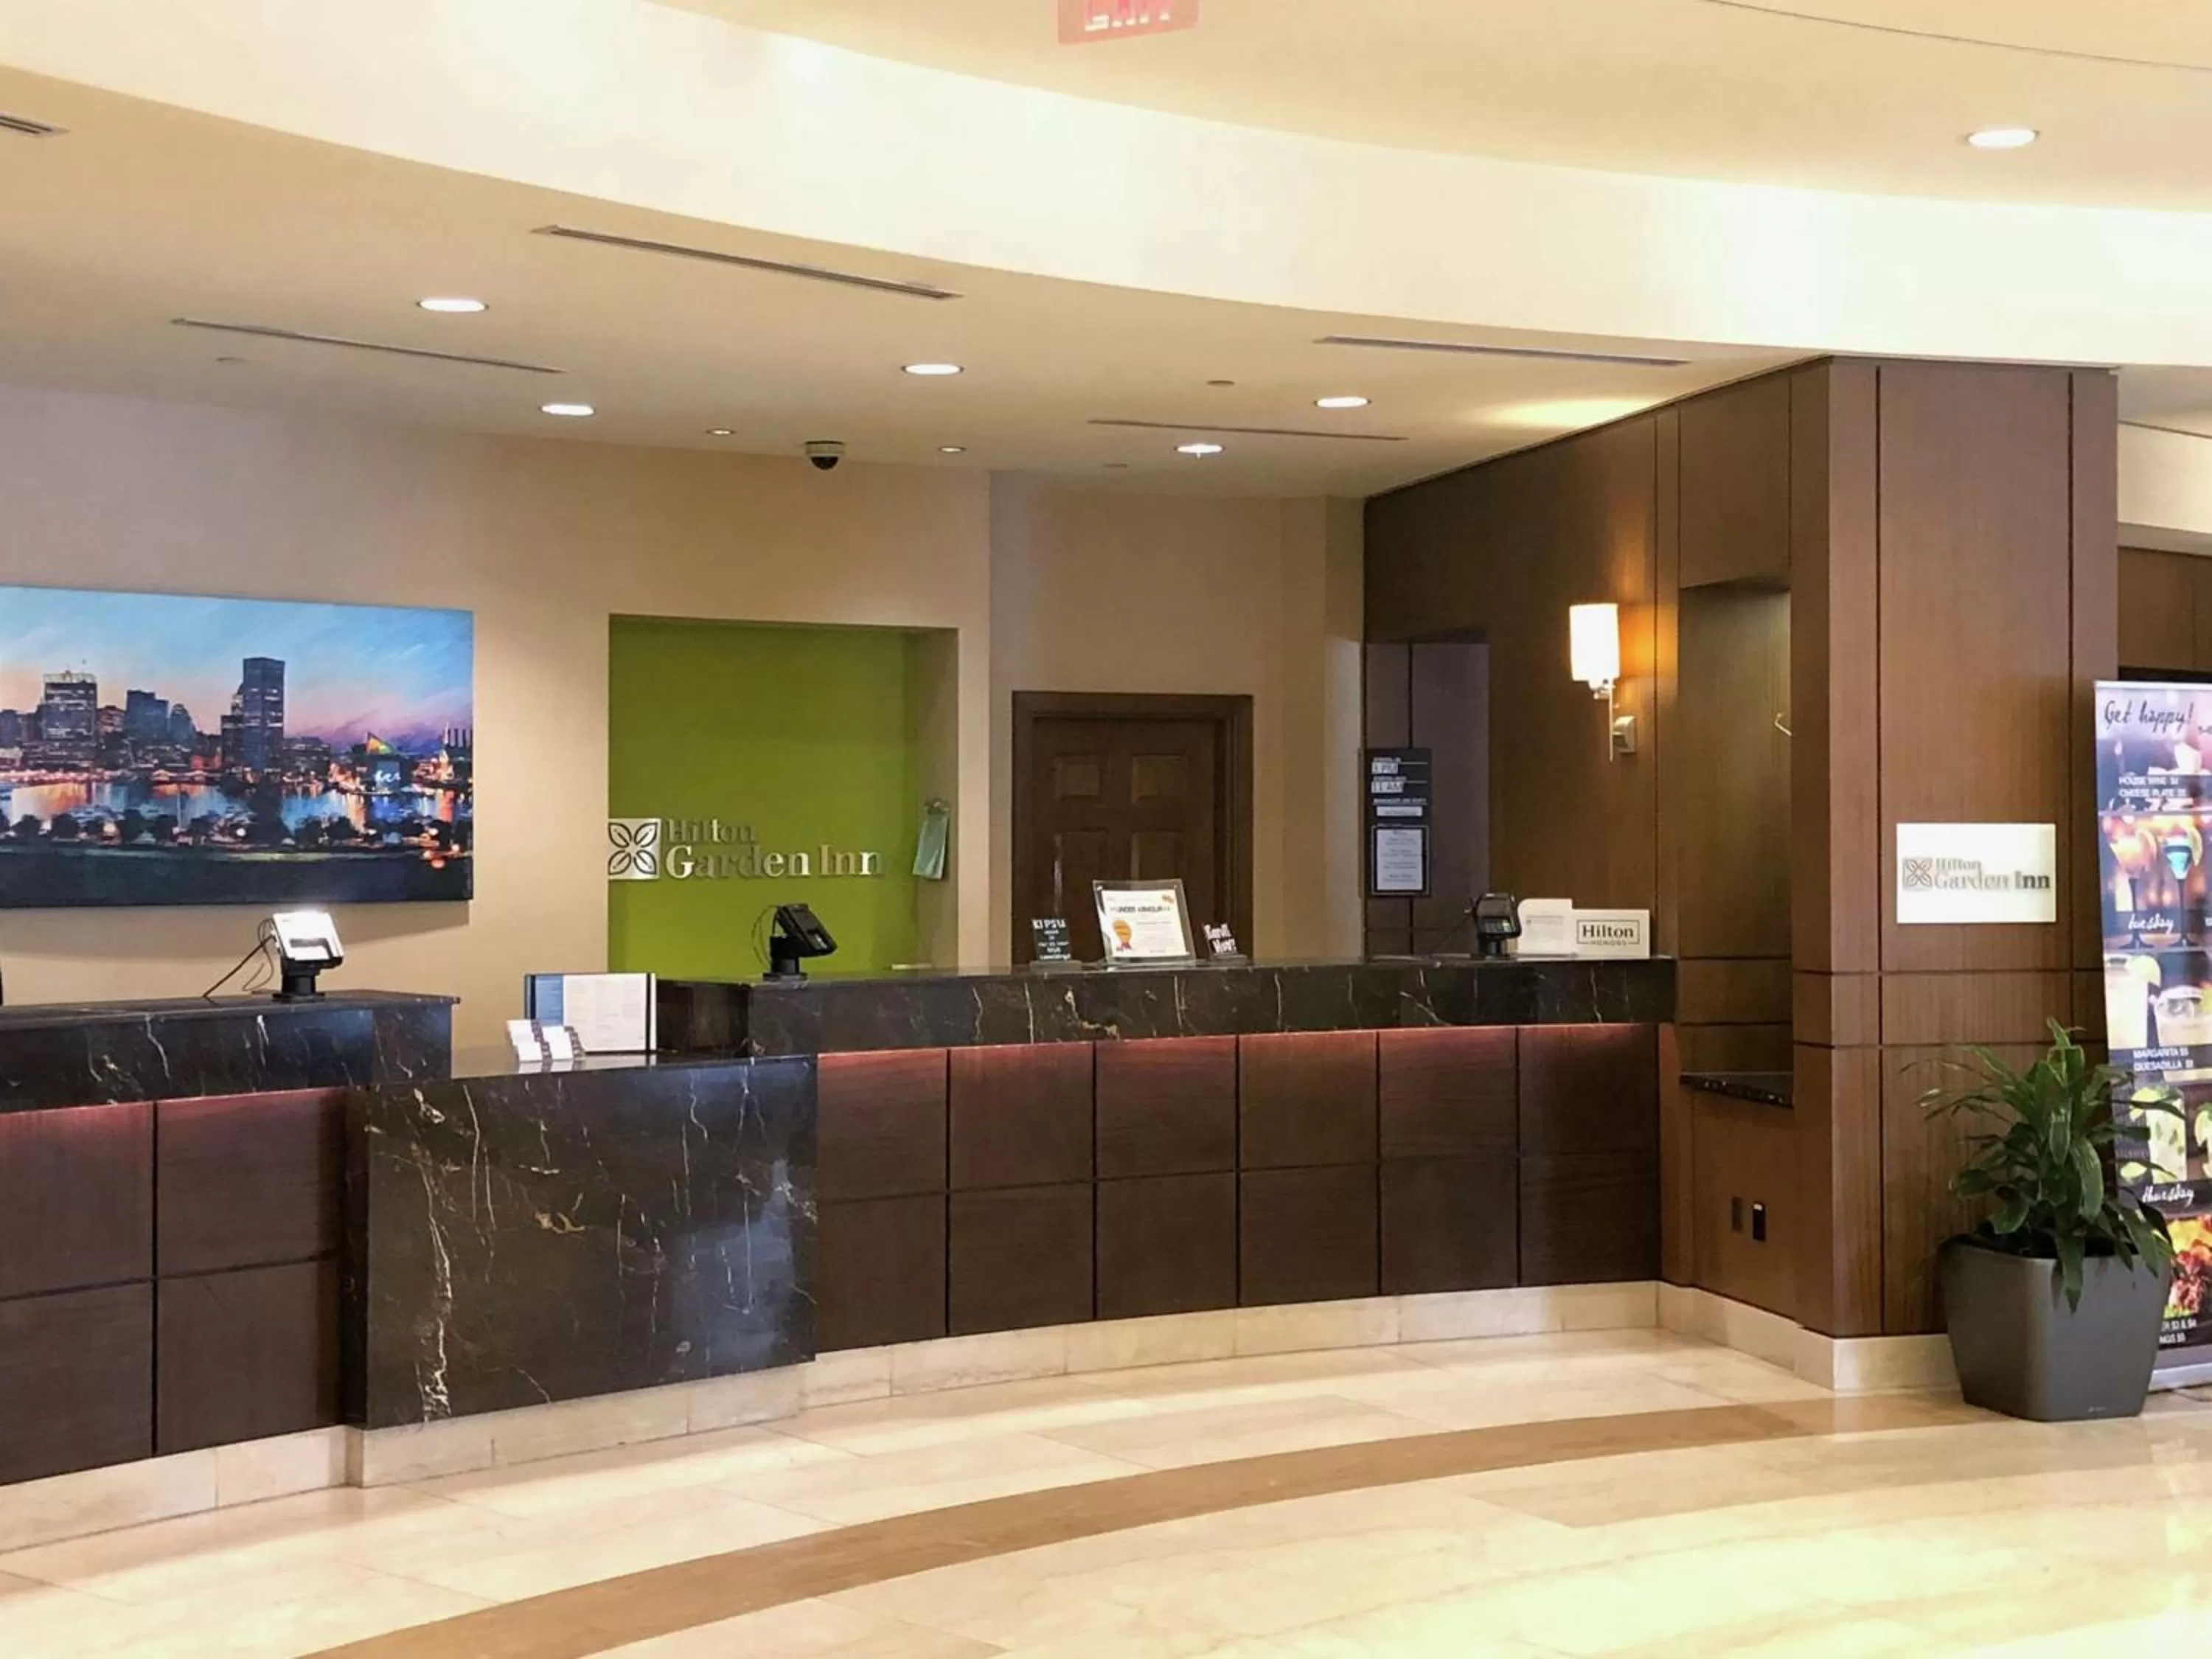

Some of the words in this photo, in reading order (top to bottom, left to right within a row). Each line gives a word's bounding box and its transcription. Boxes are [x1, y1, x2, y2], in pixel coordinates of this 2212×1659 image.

[2104, 700, 2132, 730] Get
[2138, 700, 2194, 734] happy!
[668, 818, 756, 843] Hilton
[665, 845, 811, 879] Garden
[818, 845, 884, 877] Inn
[1935, 858, 1982, 870] Hilton
[1933, 869, 2010, 891] Garden
[2014, 871, 2051, 889] Inn
[1582, 924, 1635, 938] Hilton
[2133, 1048, 2179, 1059] MARGARITA
[2133, 1060, 2183, 1071] QUESADILLA
